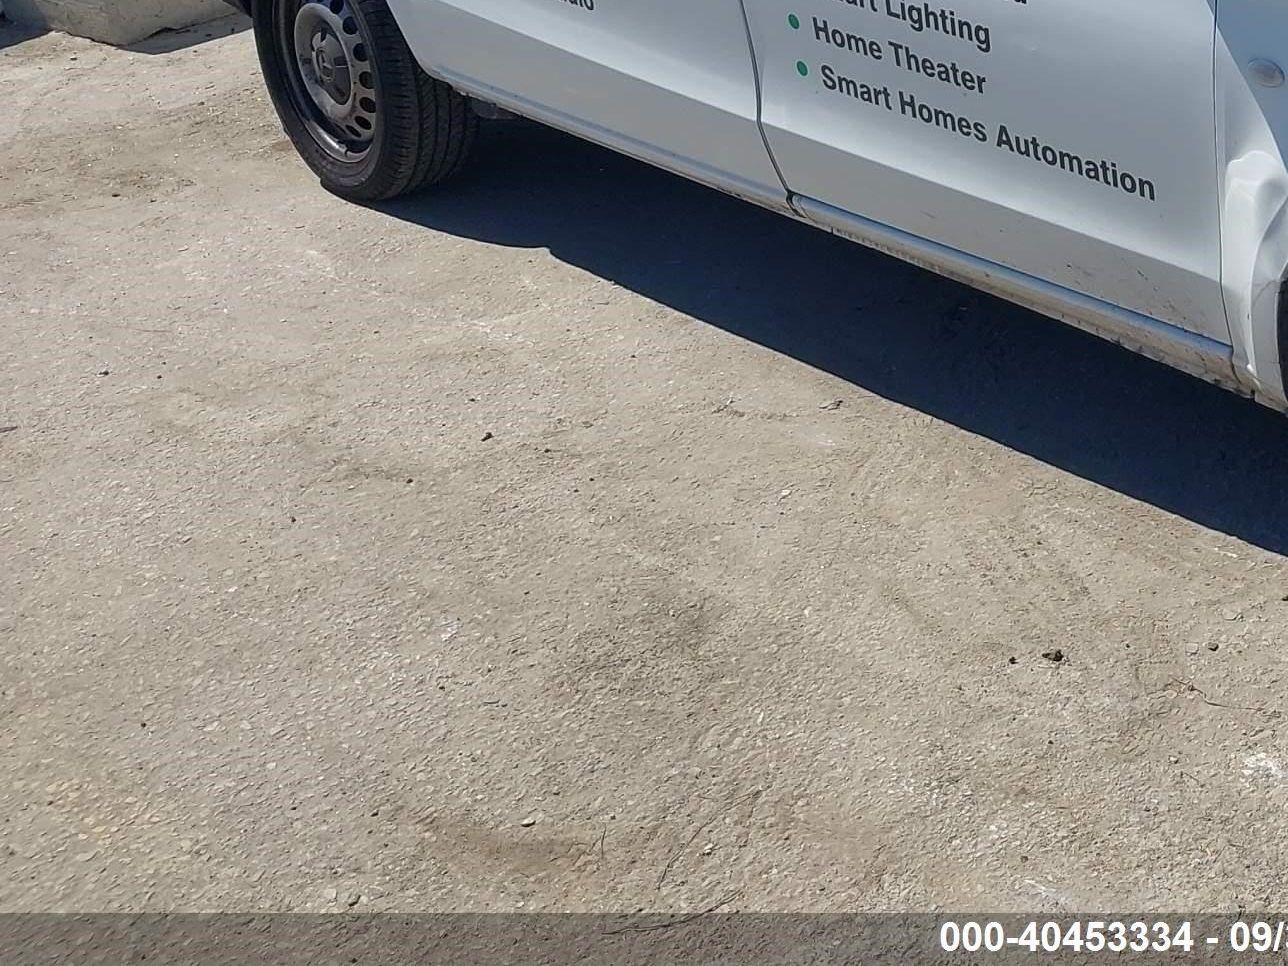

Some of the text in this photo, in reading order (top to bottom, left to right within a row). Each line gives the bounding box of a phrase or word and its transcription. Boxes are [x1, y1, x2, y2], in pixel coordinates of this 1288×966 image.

[812, 16, 987, 94] Home Theater
[820, 63, 1156, 202] Smart Homes Automation
